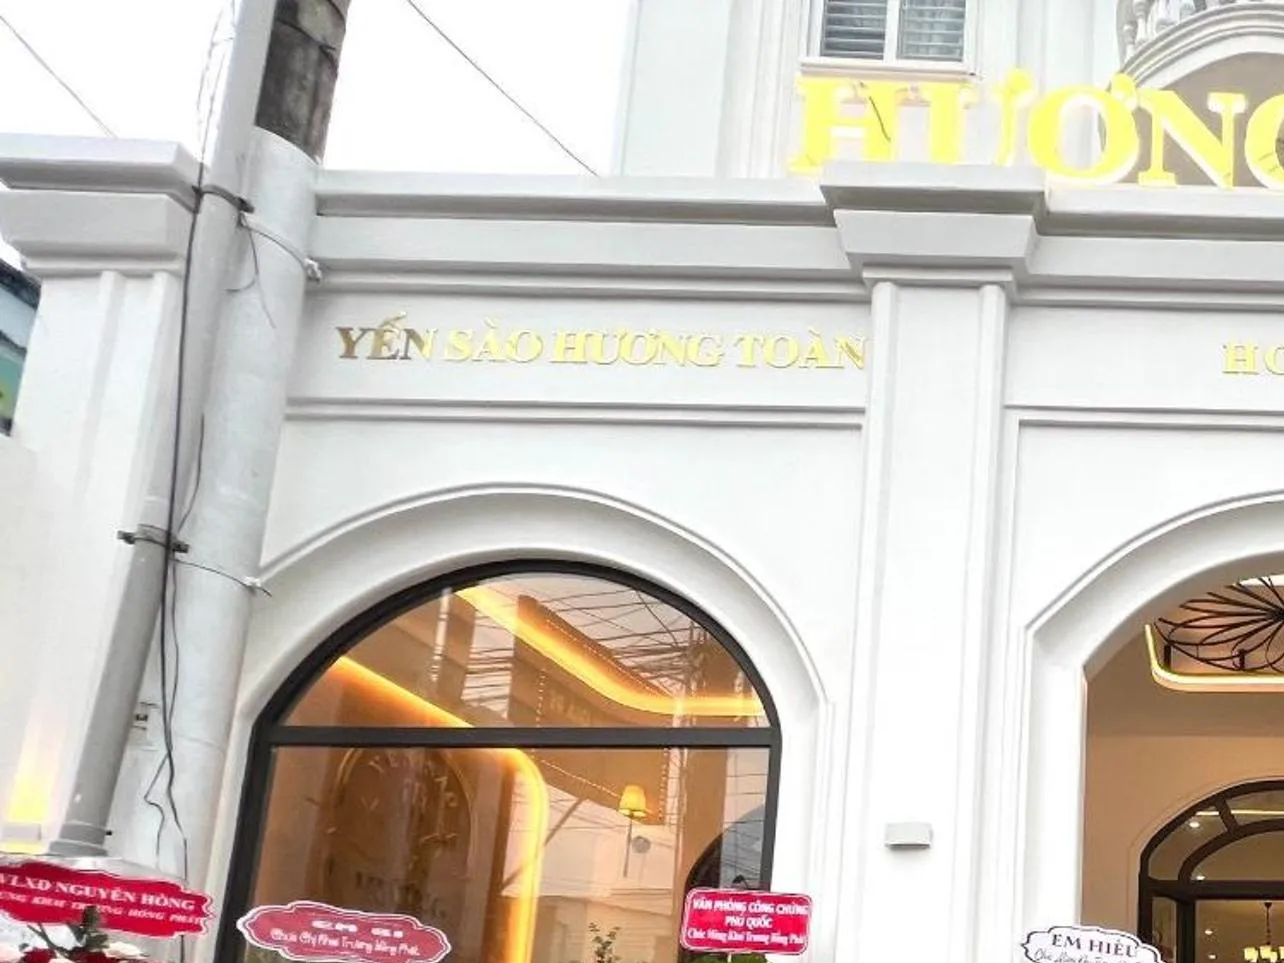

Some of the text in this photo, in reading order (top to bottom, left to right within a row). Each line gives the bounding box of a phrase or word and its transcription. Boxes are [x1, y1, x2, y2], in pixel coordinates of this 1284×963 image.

[335, 311, 867, 371] YẾN SÀO HƯƠNG TOÀN
[1051, 933, 1082, 950] EM
